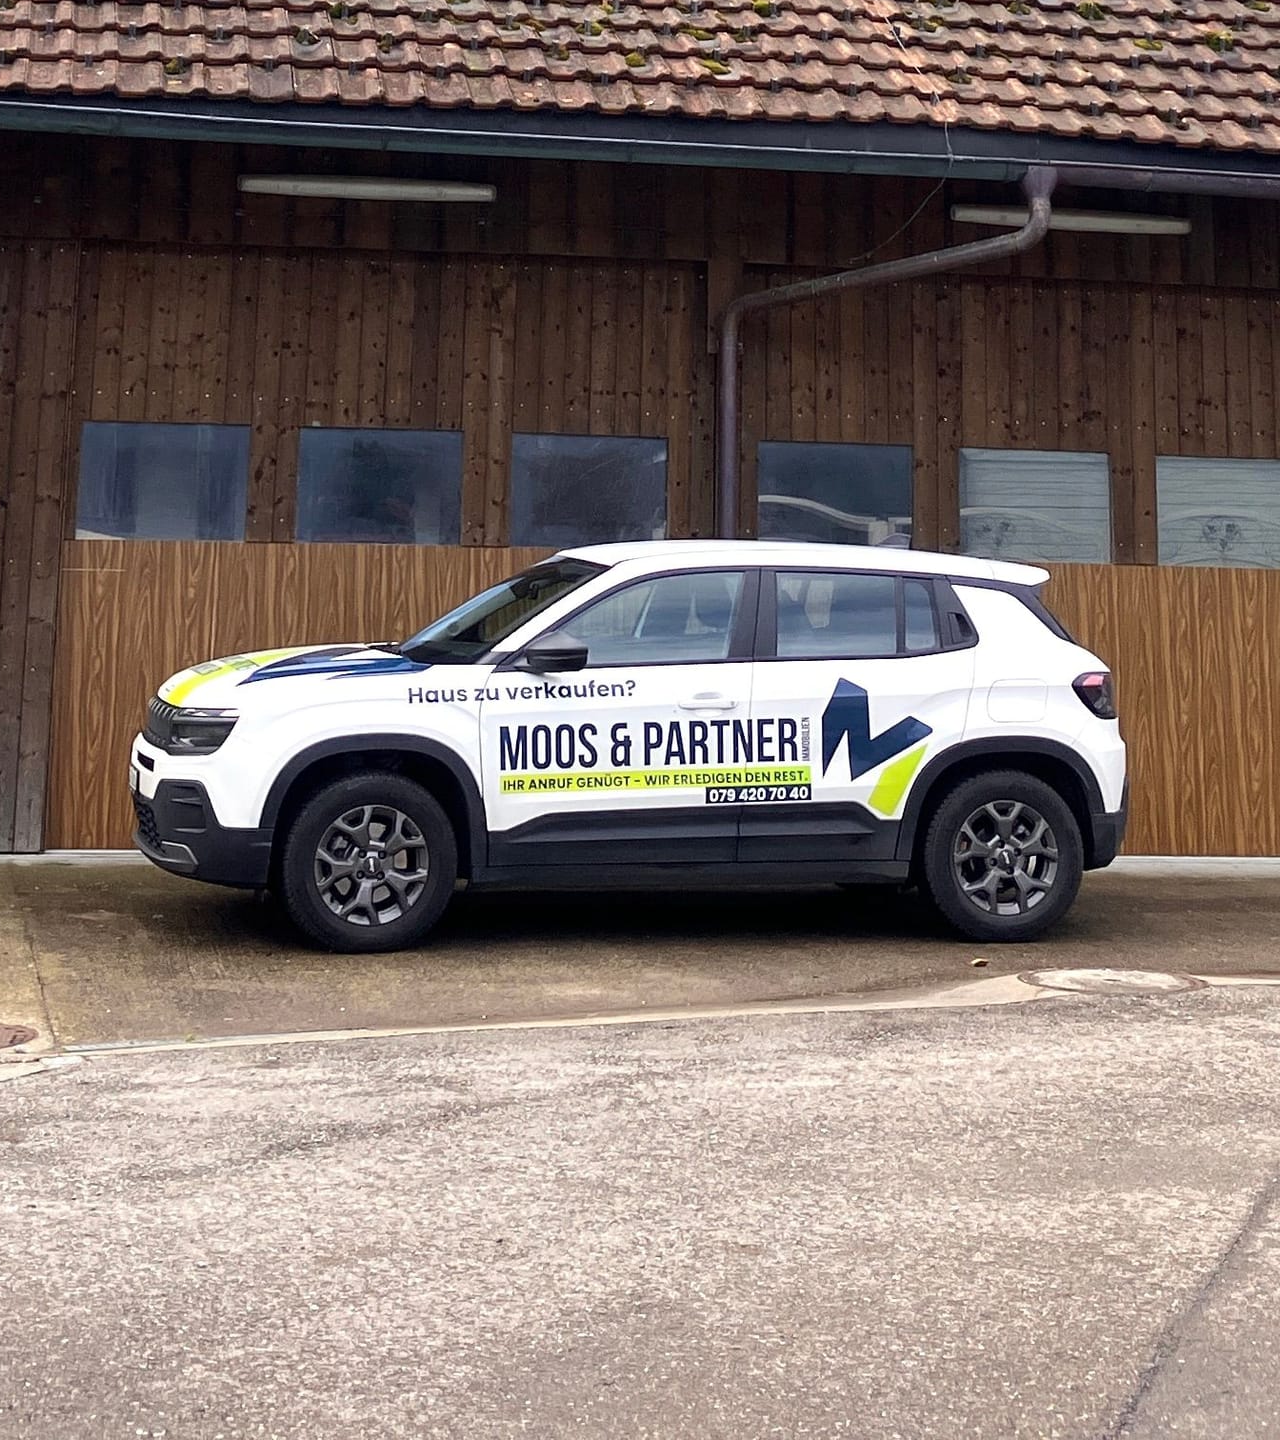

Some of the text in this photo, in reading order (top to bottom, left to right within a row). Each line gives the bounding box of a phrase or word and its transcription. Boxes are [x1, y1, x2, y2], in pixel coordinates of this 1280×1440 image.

[408, 680, 636, 703] Haus zu verkaufen?
[500, 718, 798, 770] MOOS & PARTNER
[503, 779, 525, 791] IHR
[528, 777, 573, 790] ANRUF
[576, 773, 631, 788] GENÜGT
[644, 774, 670, 786] WIR
[673, 772, 742, 785] ERLEDIGEN
[745, 771, 771, 783] DEN
[774, 770, 809, 782] REST.
[709, 786, 809, 802] 079 420 70 40
